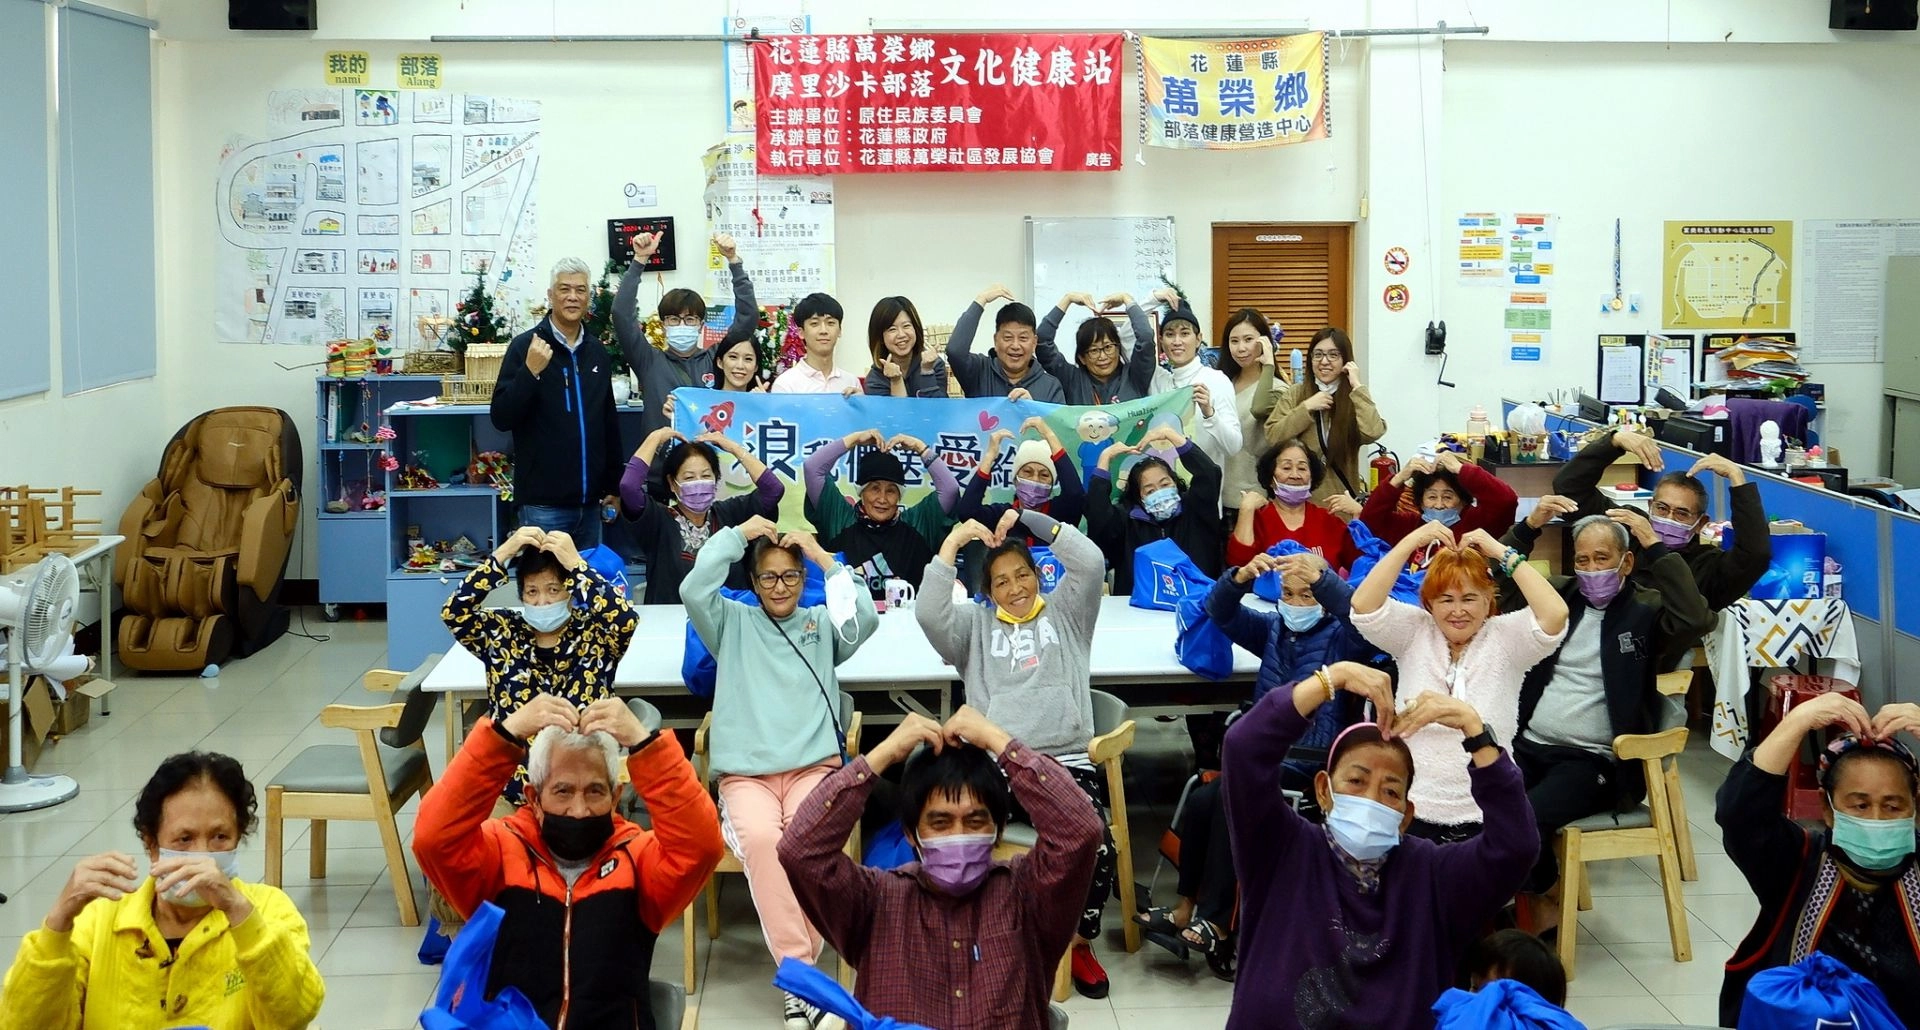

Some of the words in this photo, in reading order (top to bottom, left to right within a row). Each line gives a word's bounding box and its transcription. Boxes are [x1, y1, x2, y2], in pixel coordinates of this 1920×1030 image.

[768, 36, 936, 65] 花蓮縣萬榮鄉
[1190, 51, 1280, 73] 花蓮縣
[329, 54, 367, 74] 我的
[400, 56, 439, 77] 部落
[939, 47, 1114, 88] 文化健康站
[335, 75, 361, 84] nami
[406, 77, 435, 88] Alang
[768, 71, 936, 99] 摩里沙卡部落
[1162, 72, 1309, 117] 萬榮鄉
[1164, 115, 1312, 142] 部落健康營造中心
[1085, 152, 1112, 167] 廣告
[991, 616, 1060, 659] USA
